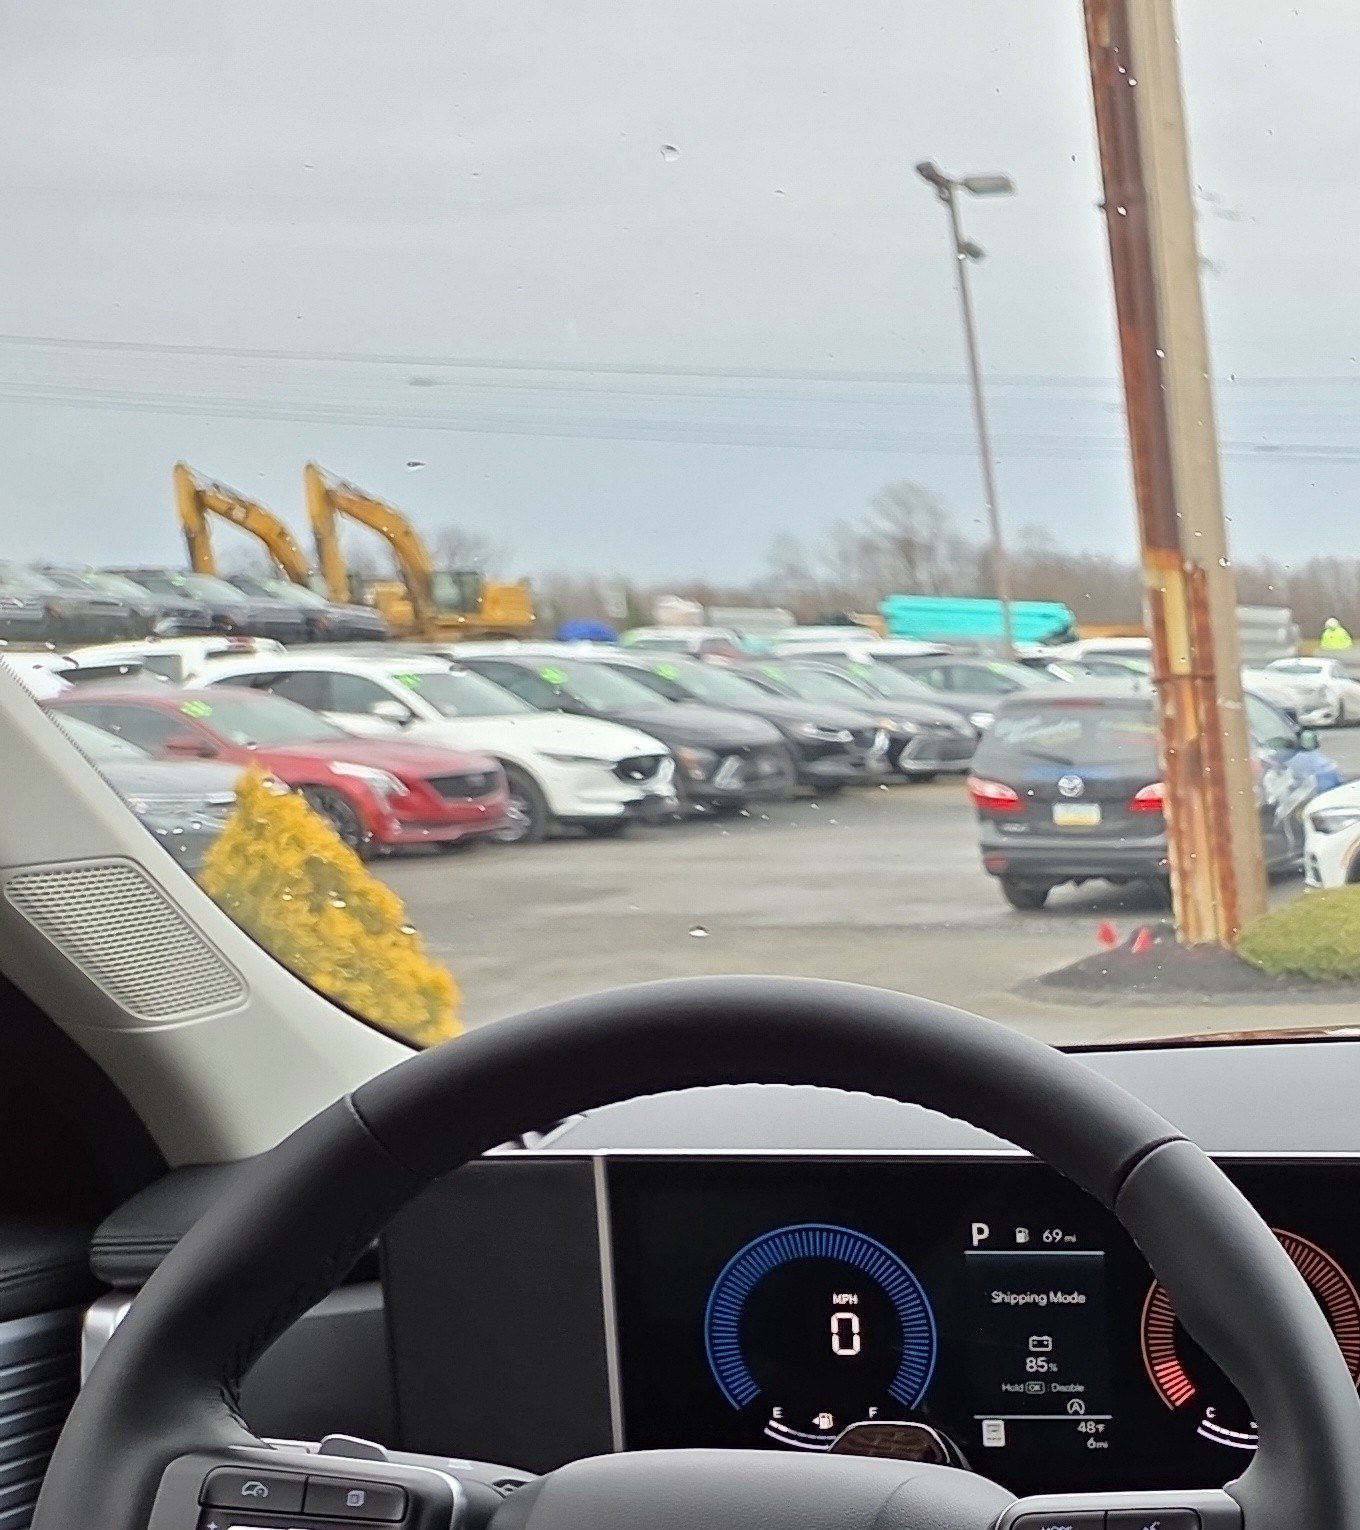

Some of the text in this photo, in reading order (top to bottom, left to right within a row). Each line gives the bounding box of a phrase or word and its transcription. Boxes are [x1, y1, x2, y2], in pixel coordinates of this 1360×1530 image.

[971, 1222, 990, 1247] P
[833, 1292, 858, 1305] MPH
[991, 1290, 1087, 1306] Shipping Mode
[830, 1311, 861, 1356] 0
[1001, 1382, 1024, 1393] Hold
[772, 1406, 784, 1419] E
[868, 1406, 879, 1419] F
[1205, 1406, 1216, 1419] C
